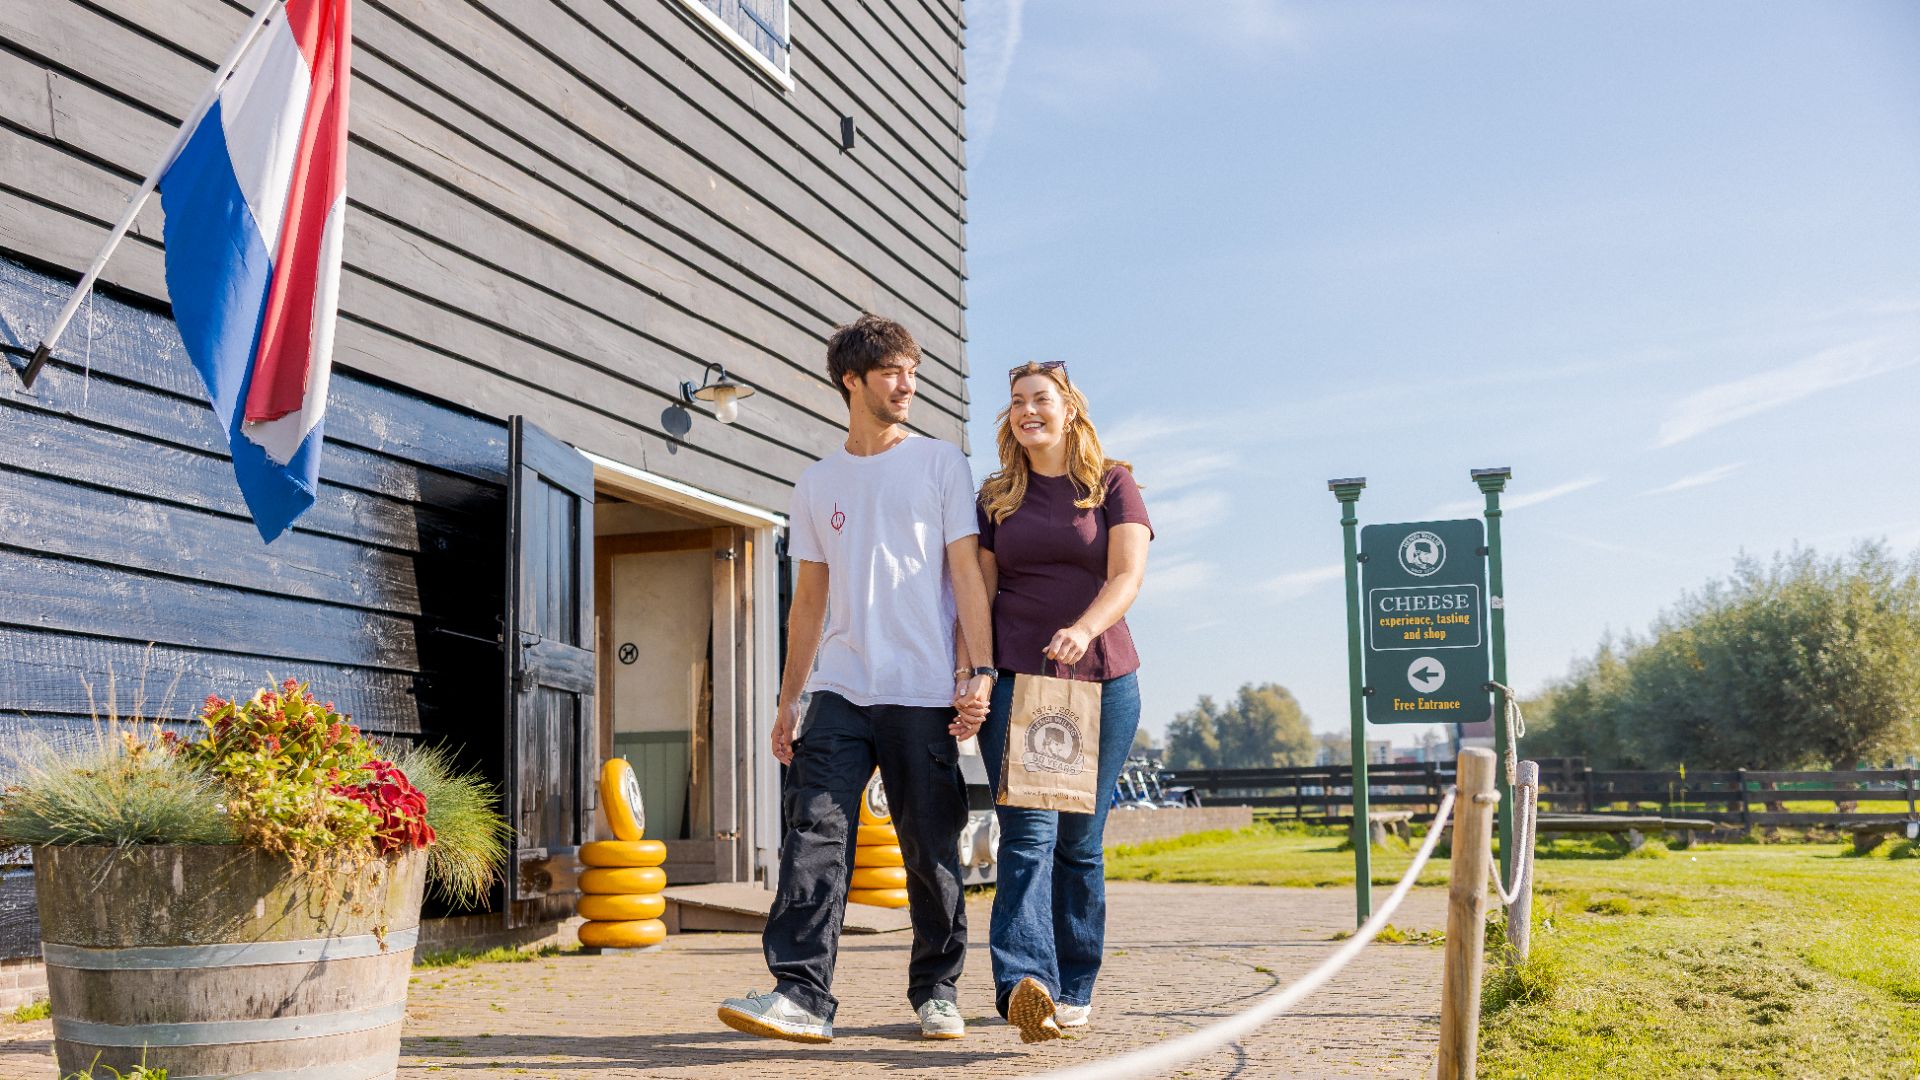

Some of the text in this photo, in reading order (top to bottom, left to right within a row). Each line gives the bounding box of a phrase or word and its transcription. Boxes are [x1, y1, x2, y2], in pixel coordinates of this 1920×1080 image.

[1379, 594, 1469, 612] CHEESE
[1380, 612, 1470, 627] experience, tasting
[1403, 627, 1446, 640] and shop
[1393, 697, 1460, 710] Free Entrance
[1031, 716, 1077, 737] HENRI WILLIG
[1048, 757, 1076, 774] YEARS
